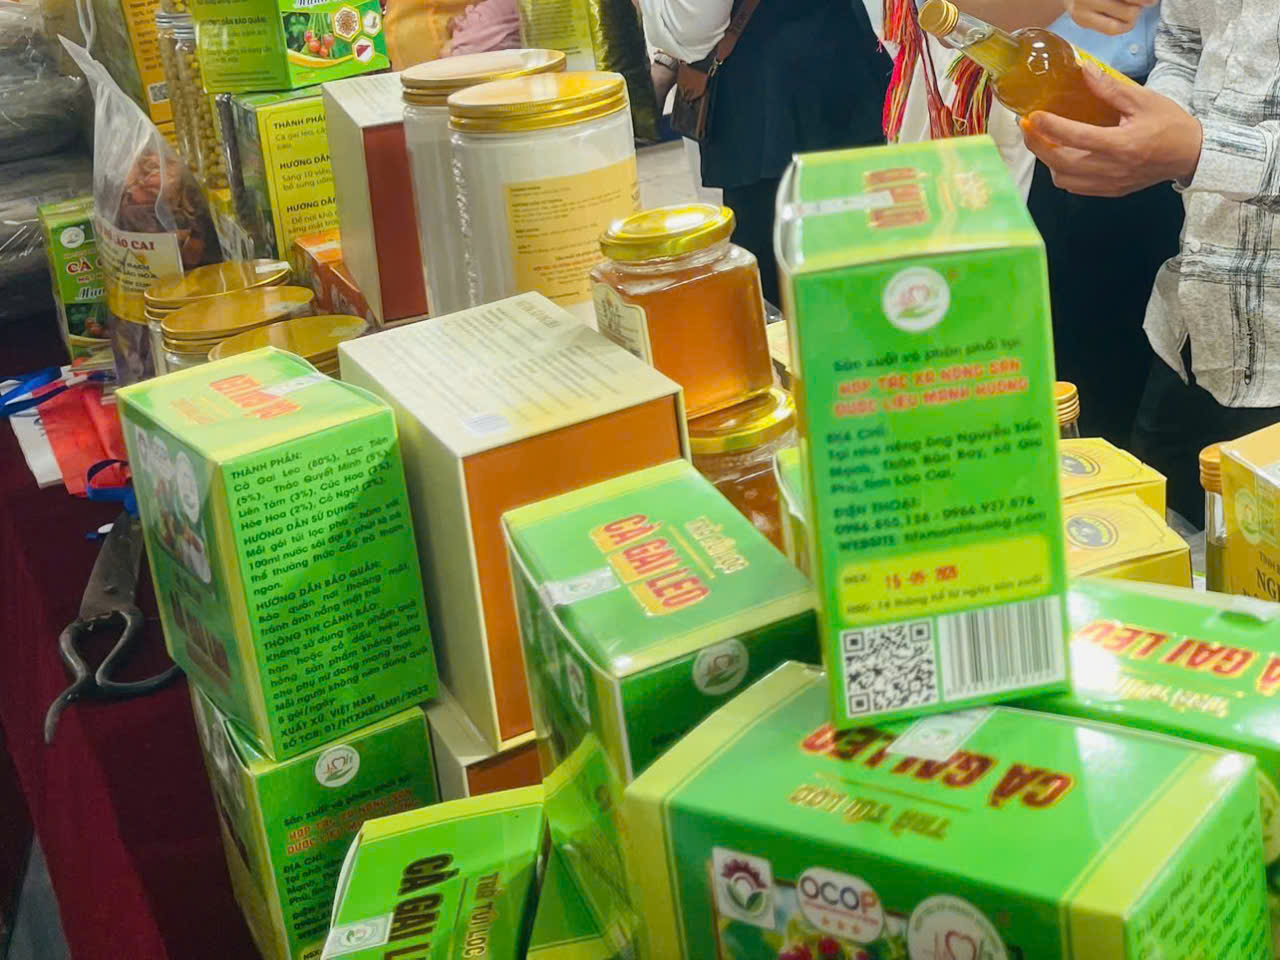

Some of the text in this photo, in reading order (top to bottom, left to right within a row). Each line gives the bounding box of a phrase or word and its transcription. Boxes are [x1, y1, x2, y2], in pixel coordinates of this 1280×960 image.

[231, 451, 303, 480] THÀNH PHẦN:
[234, 482, 250, 493] Cà
[256, 474, 276, 486] Gai
[282, 466, 301, 478] Leo
[274, 480, 299, 494] Thảo
[303, 466, 334, 484] Quyết
[338, 458, 362, 473] Minh
[238, 505, 261, 519] Liên
[263, 497, 286, 511] Tâm
[320, 479, 341, 492] Cúc
[344, 471, 365, 484] Hoa
[243, 526, 284, 547] HƯỚNG
[286, 516, 310, 533] DẪN
[311, 510, 325, 524] SỬ
[265, 510, 287, 524] Hoa
[246, 545, 266, 559] Mỗi
[270, 538, 288, 553] gói
[308, 526, 325, 538] lọc
[328, 518, 350, 533] pha
[248, 553, 281, 571] 100ml
[282, 545, 310, 560] nước
[310, 537, 326, 551] sôi
[621, 538, 682, 577] GAI
[272, 559, 309, 577] thưởng
[253, 581, 282, 596] ngon.
[255, 591, 297, 611] HƯỚNG
[299, 581, 323, 597] DẪN
[324, 571, 347, 588] BẢO
[644, 566, 711, 609] LEO
[263, 630, 301, 651] THÔNG
[303, 623, 322, 638] TIN
[322, 612, 354, 630] CẢNH
[1160, 637, 1258, 678] GAI
[352, 692, 377, 710] NAM
[987, 762, 1075, 810] CÀ
[397, 852, 461, 897] CÀ
[801, 876, 878, 913] OCOP
[386, 892, 443, 942] GAI
